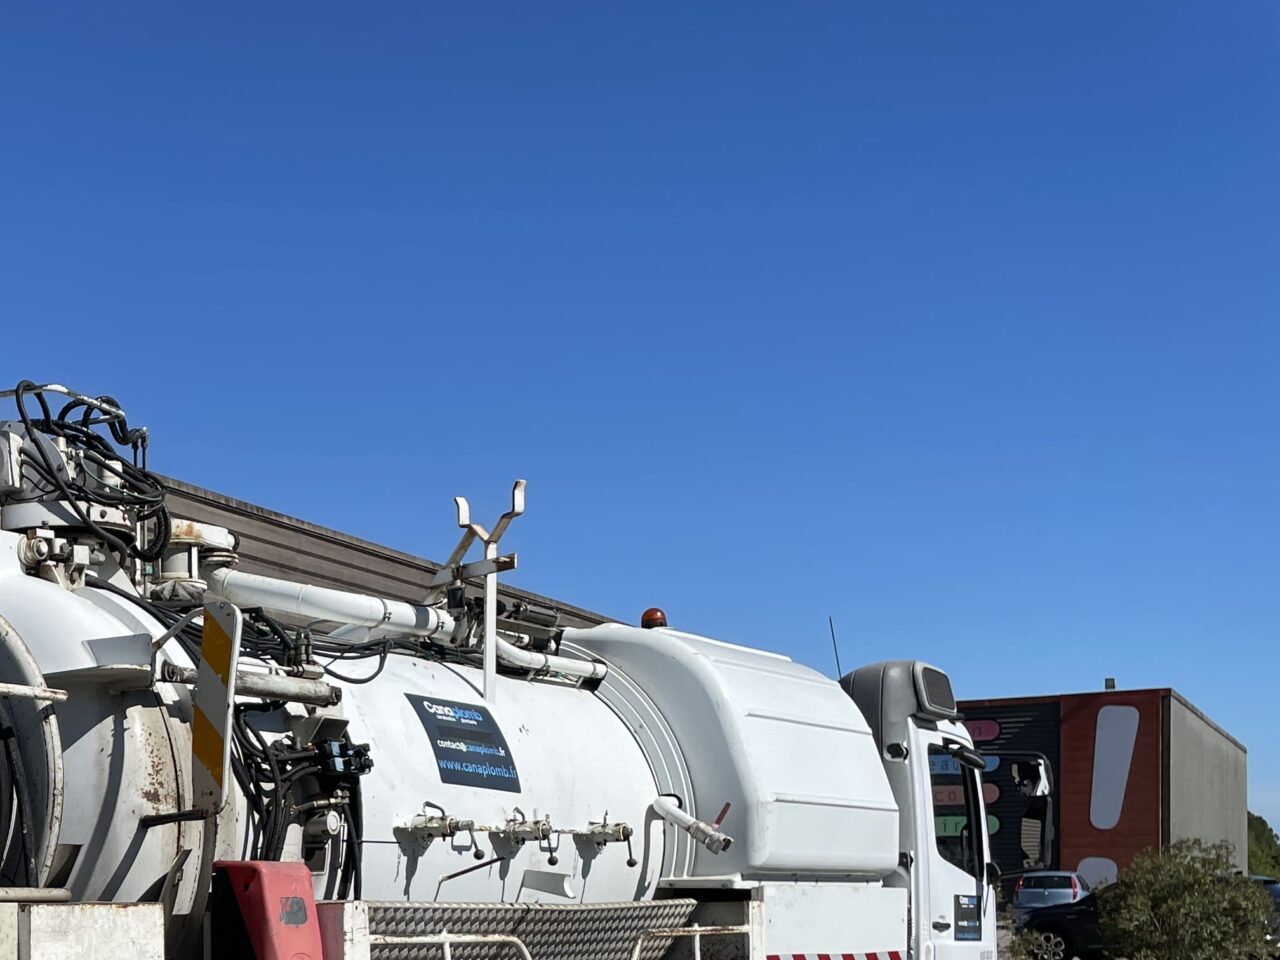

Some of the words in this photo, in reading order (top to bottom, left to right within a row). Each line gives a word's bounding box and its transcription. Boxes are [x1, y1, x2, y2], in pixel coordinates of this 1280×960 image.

[423, 701, 483, 721] Canaplomb
[437, 740, 506, 757] contact@canaplomb.fr
[438, 759, 517, 778] www.canaplomb.fr
